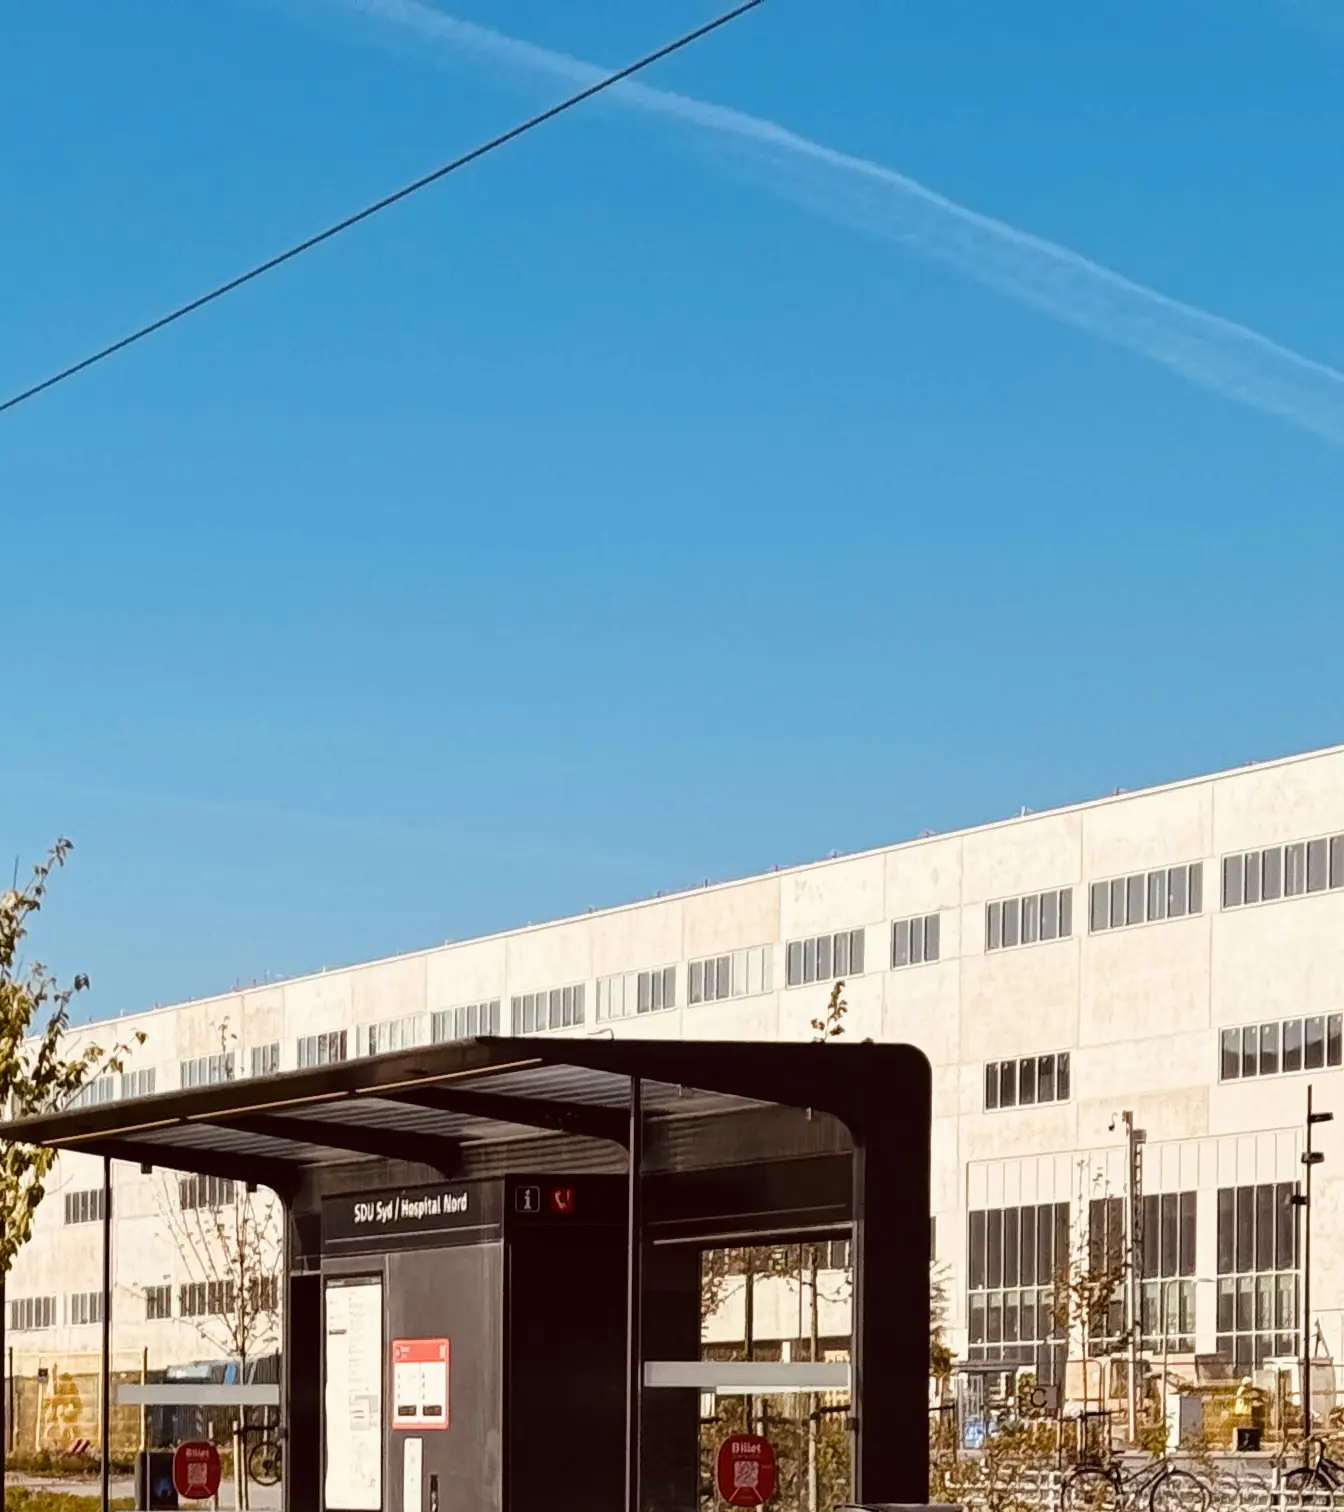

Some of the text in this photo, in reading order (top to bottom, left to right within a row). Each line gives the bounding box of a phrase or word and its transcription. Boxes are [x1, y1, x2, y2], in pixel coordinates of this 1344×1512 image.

[354, 1192, 468, 1223] SDU Syd / Hospital Nord
[731, 1441, 762, 1454] Billet
